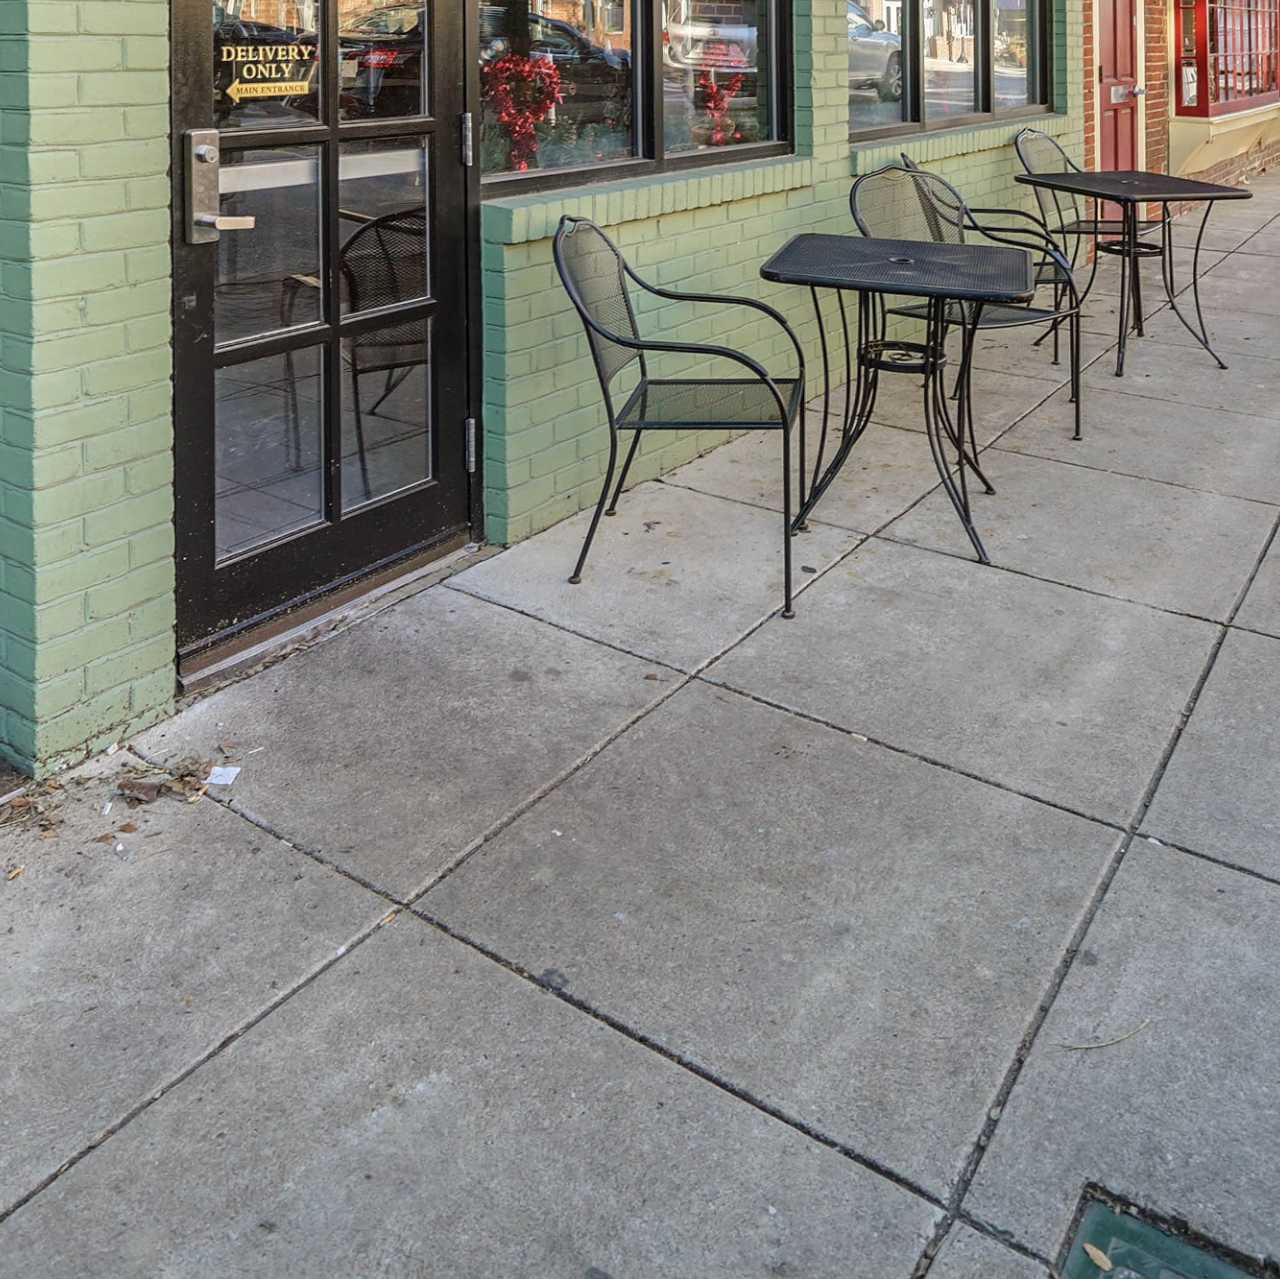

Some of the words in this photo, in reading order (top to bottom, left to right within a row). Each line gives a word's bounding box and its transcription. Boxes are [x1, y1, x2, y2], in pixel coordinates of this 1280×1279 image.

[221, 45, 314, 62] DELIVERY
[242, 63, 294, 79] ONLY
[236, 86, 258, 96] MAIN
[261, 85, 305, 95] ENTRANCE
